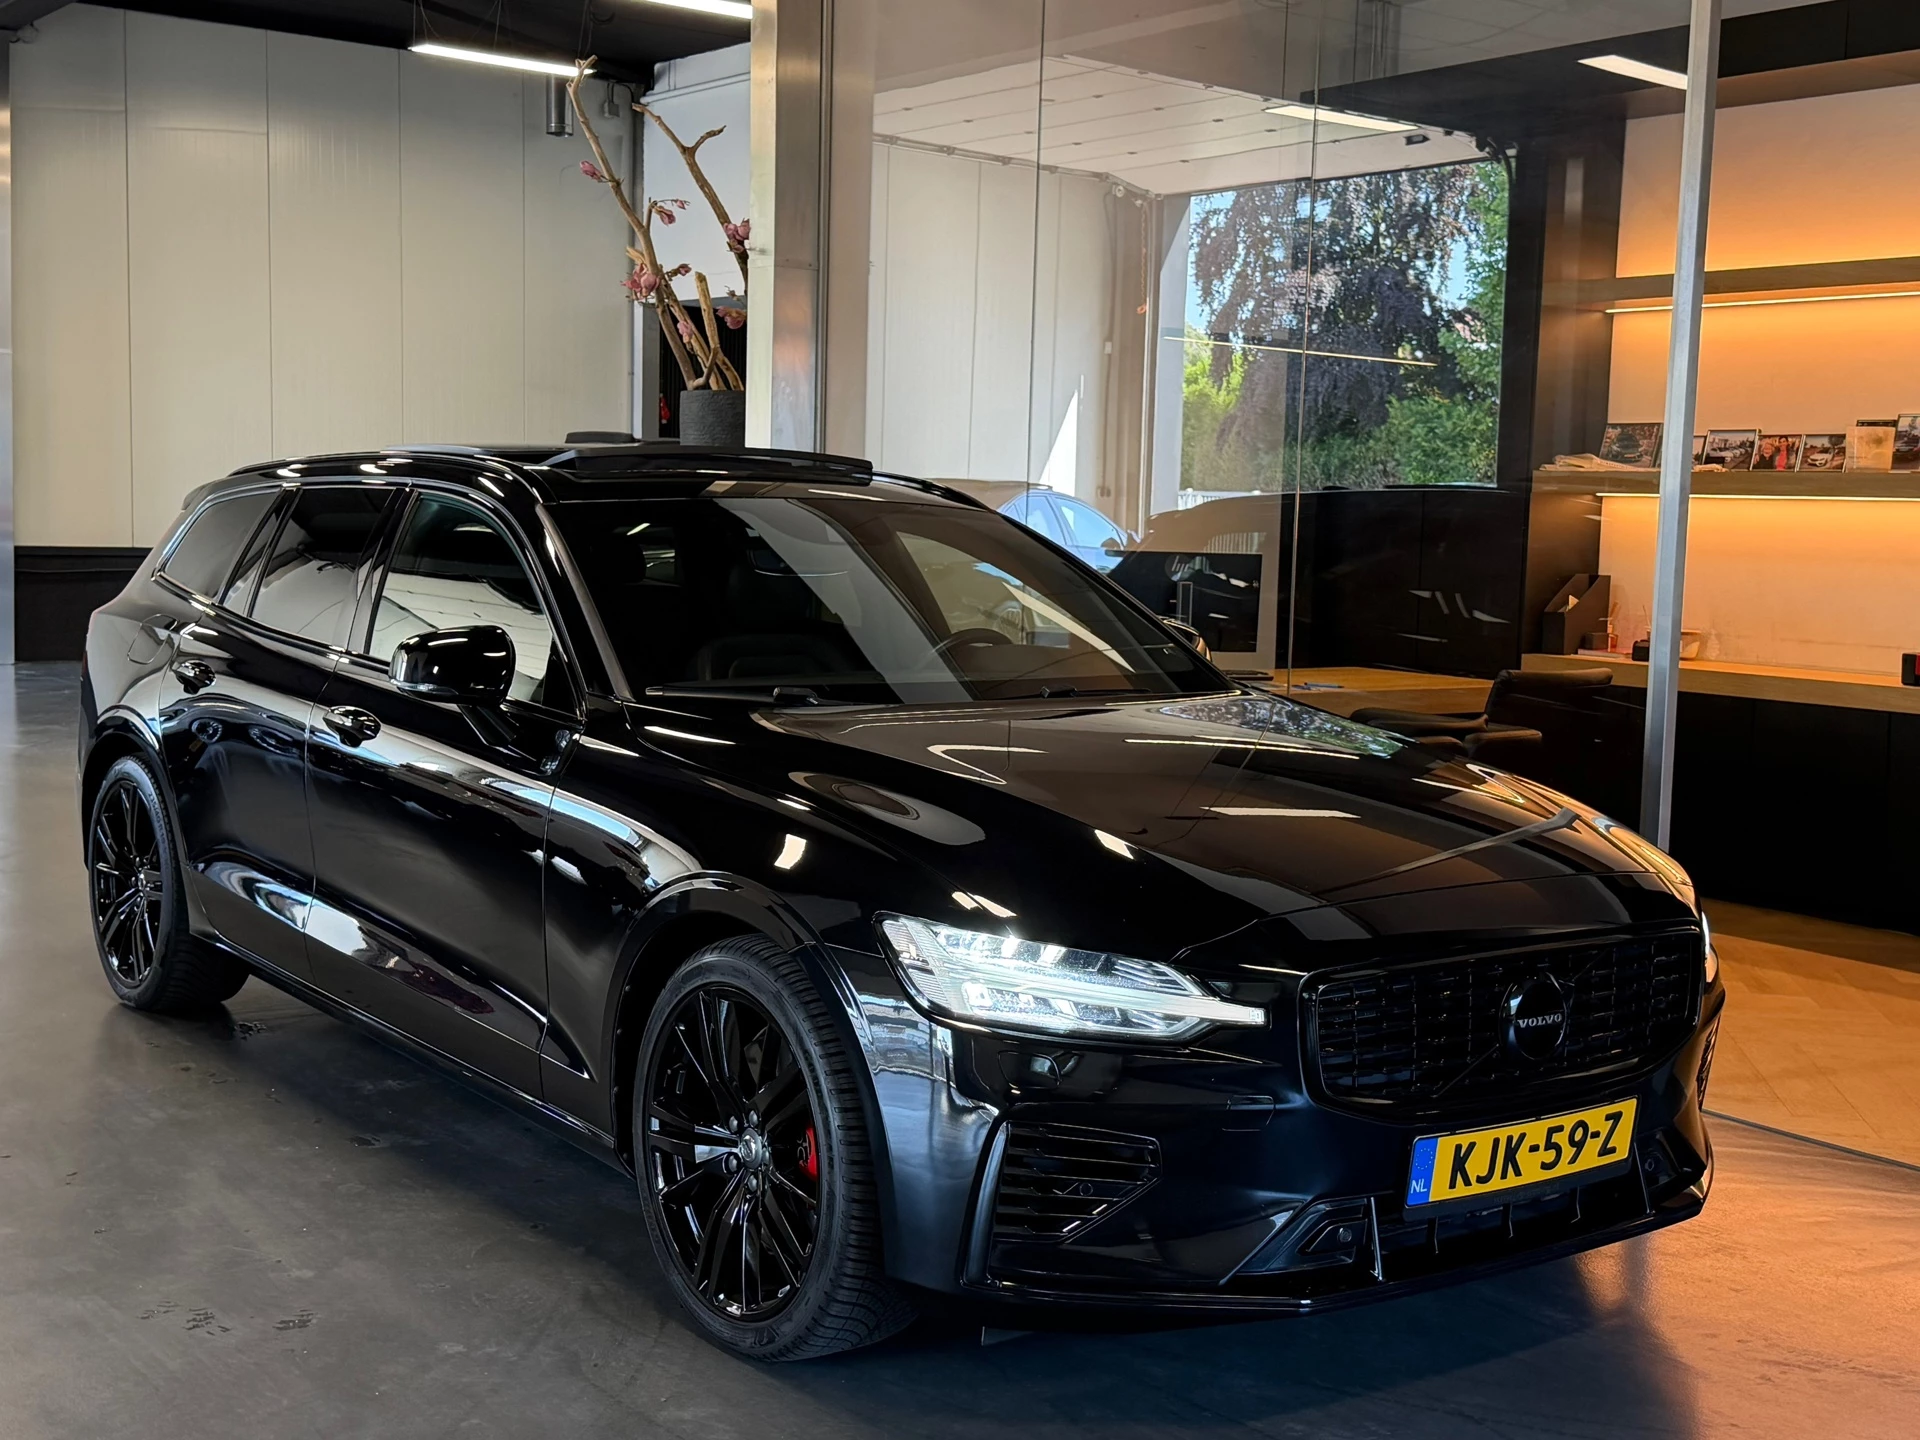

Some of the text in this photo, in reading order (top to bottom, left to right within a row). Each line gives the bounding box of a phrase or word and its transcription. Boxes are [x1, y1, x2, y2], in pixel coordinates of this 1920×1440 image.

[1517, 1013, 1562, 1028] VOLVO
[1448, 1110, 1624, 1190] KJK-59-Z
[1410, 1178, 1428, 1194] NL
